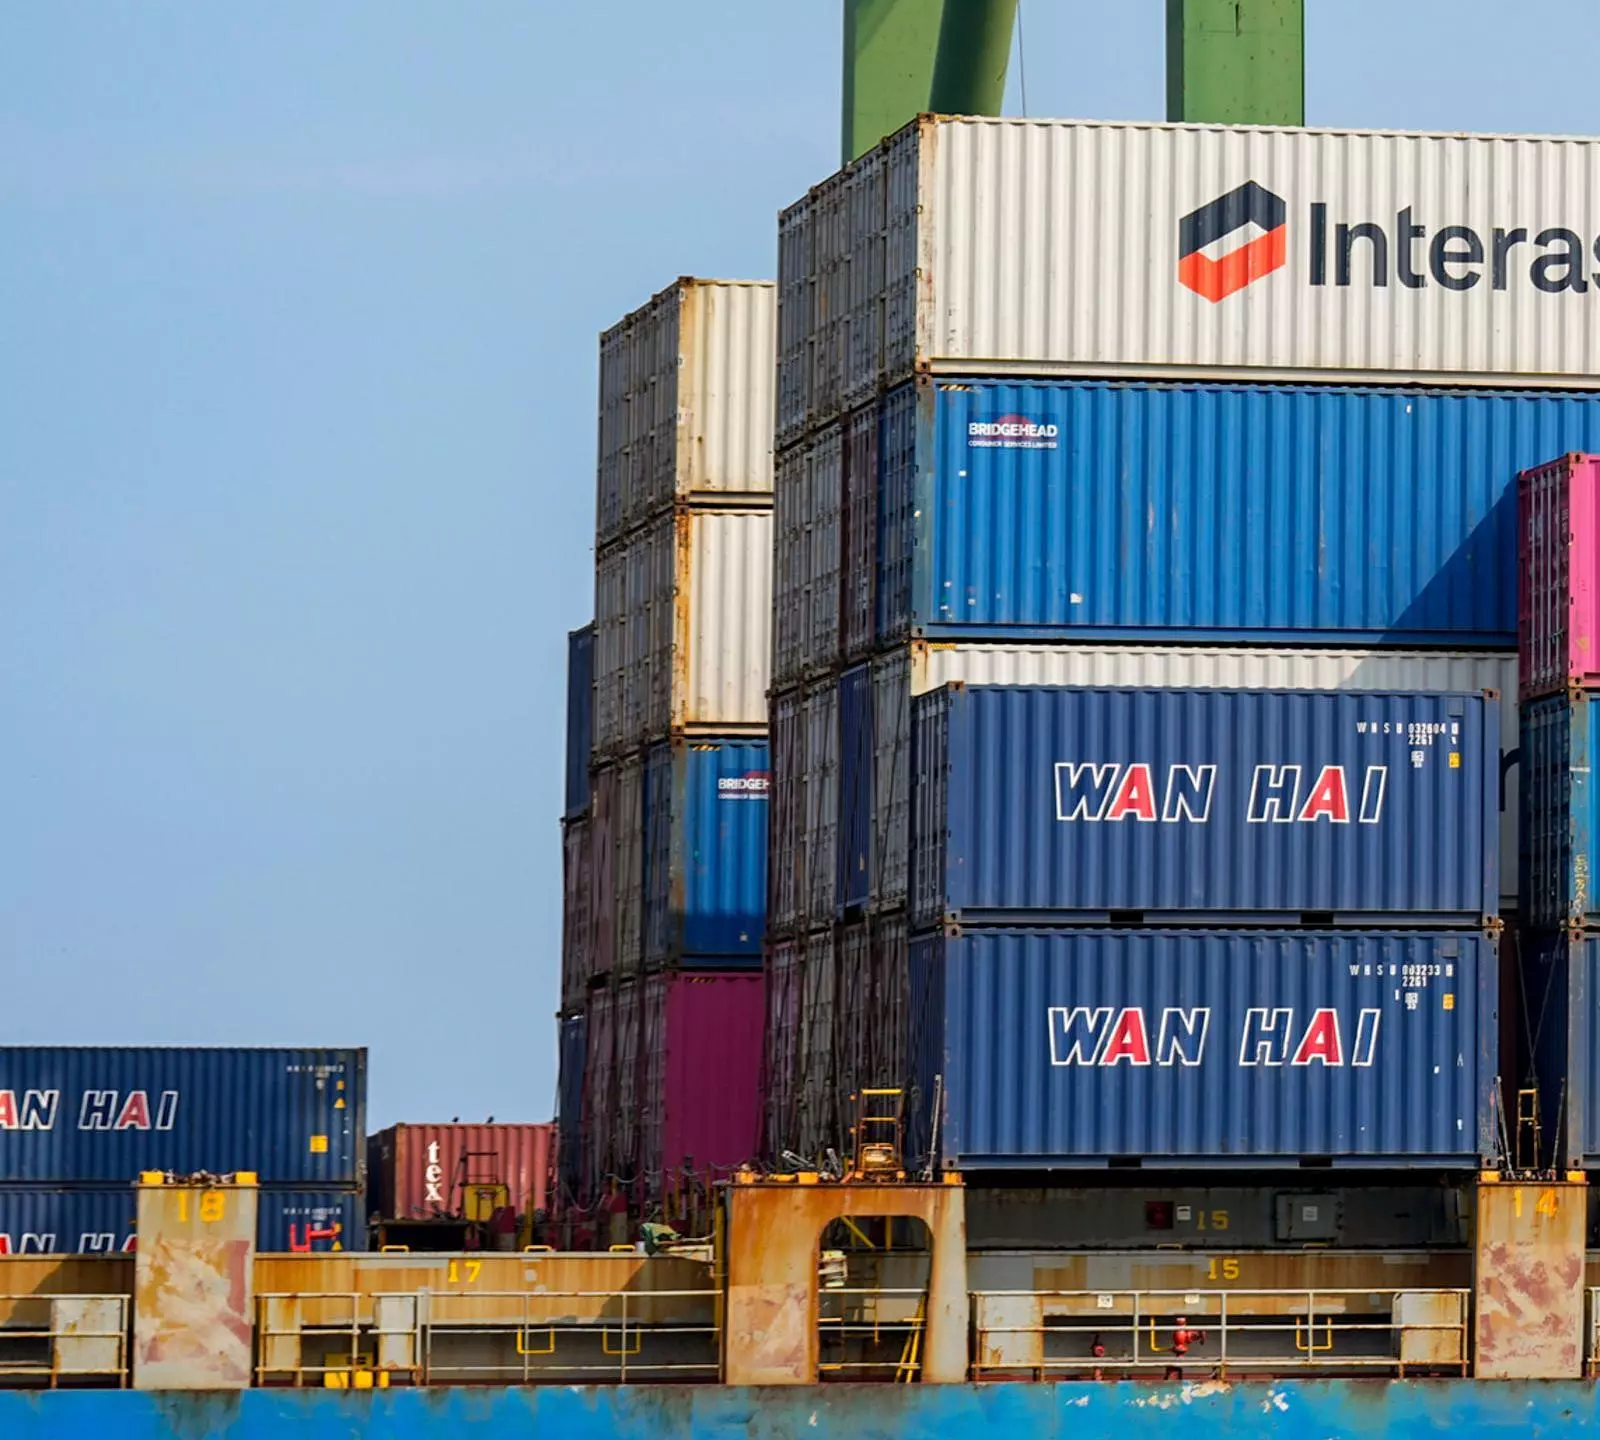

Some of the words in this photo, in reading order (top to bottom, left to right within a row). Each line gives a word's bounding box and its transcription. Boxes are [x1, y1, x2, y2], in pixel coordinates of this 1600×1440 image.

[968, 422, 1058, 438] BRIDGEHEAD
[1054, 762, 1217, 823] WAN
[1246, 764, 1388, 824] HAI
[1047, 1006, 1211, 1066] WAN
[1239, 1008, 1381, 1067] HAI
[77, 1090, 179, 1131] HAI
[425, 1140, 444, 1203] tex
[177, 1190, 227, 1223] 18
[1513, 1187, 1559, 1218] 14
[1197, 1209, 1230, 1230] 15
[447, 1260, 482, 1283] 17
[1206, 1258, 1240, 1280] 15
